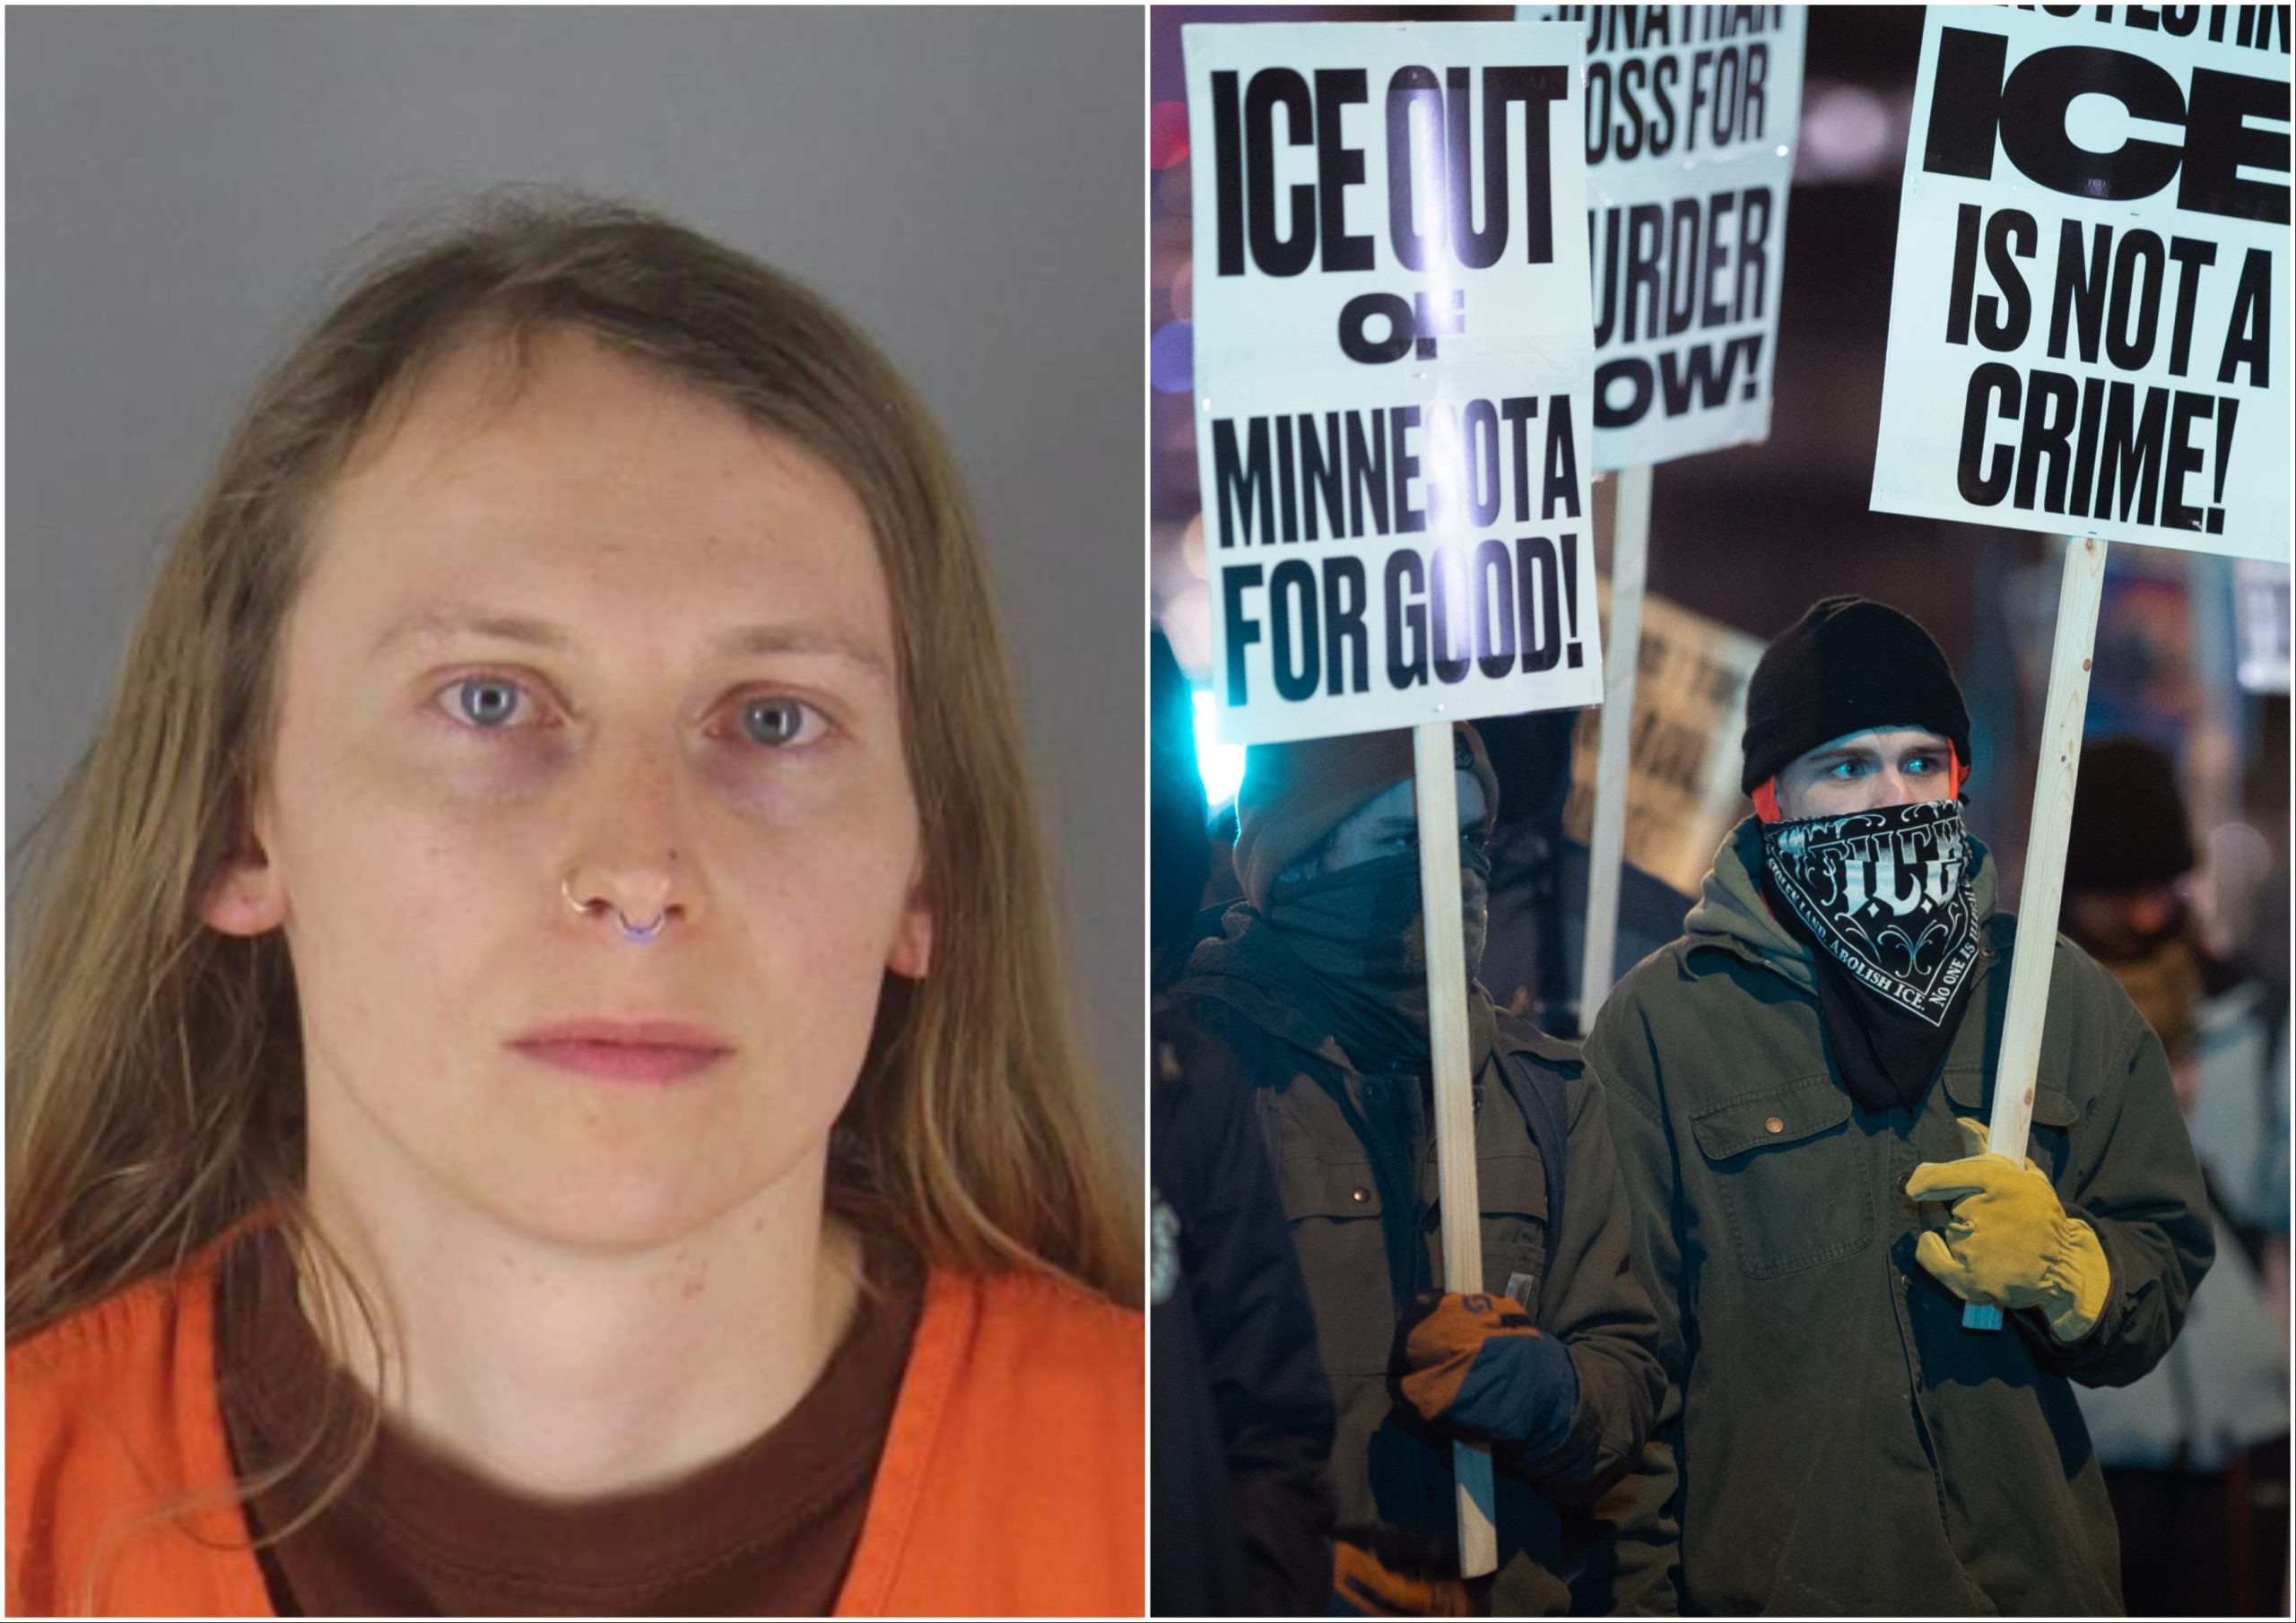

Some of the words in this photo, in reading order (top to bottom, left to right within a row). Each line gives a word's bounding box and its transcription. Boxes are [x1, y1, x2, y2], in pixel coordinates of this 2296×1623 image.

[1211, 67, 1375, 277] ICE
[1386, 65, 1569, 271] OUT
[1585, 55, 1677, 165] OSS
[1685, 42, 1768, 152] FOR
[1923, 26, 2292, 226] ICE
[1337, 290, 1465, 364] OF
[1587, 187, 1772, 350] URDER
[1946, 203, 2039, 352] IS
[2048, 217, 2219, 378] NOT
[2217, 247, 2273, 389] A
[1593, 333, 1766, 430] OW!
[1957, 361, 2240, 535] CRIME!
[1222, 555, 1370, 707] FOR
[1384, 534, 1584, 690] GOOD!
[1830, 940, 1892, 991] ABOLISH
[1893, 983, 1926, 1011] ICE.
[1929, 986, 1951, 1008] NO
[1943, 958, 1966, 985] ONE
[1959, 942, 1976, 960] IS
